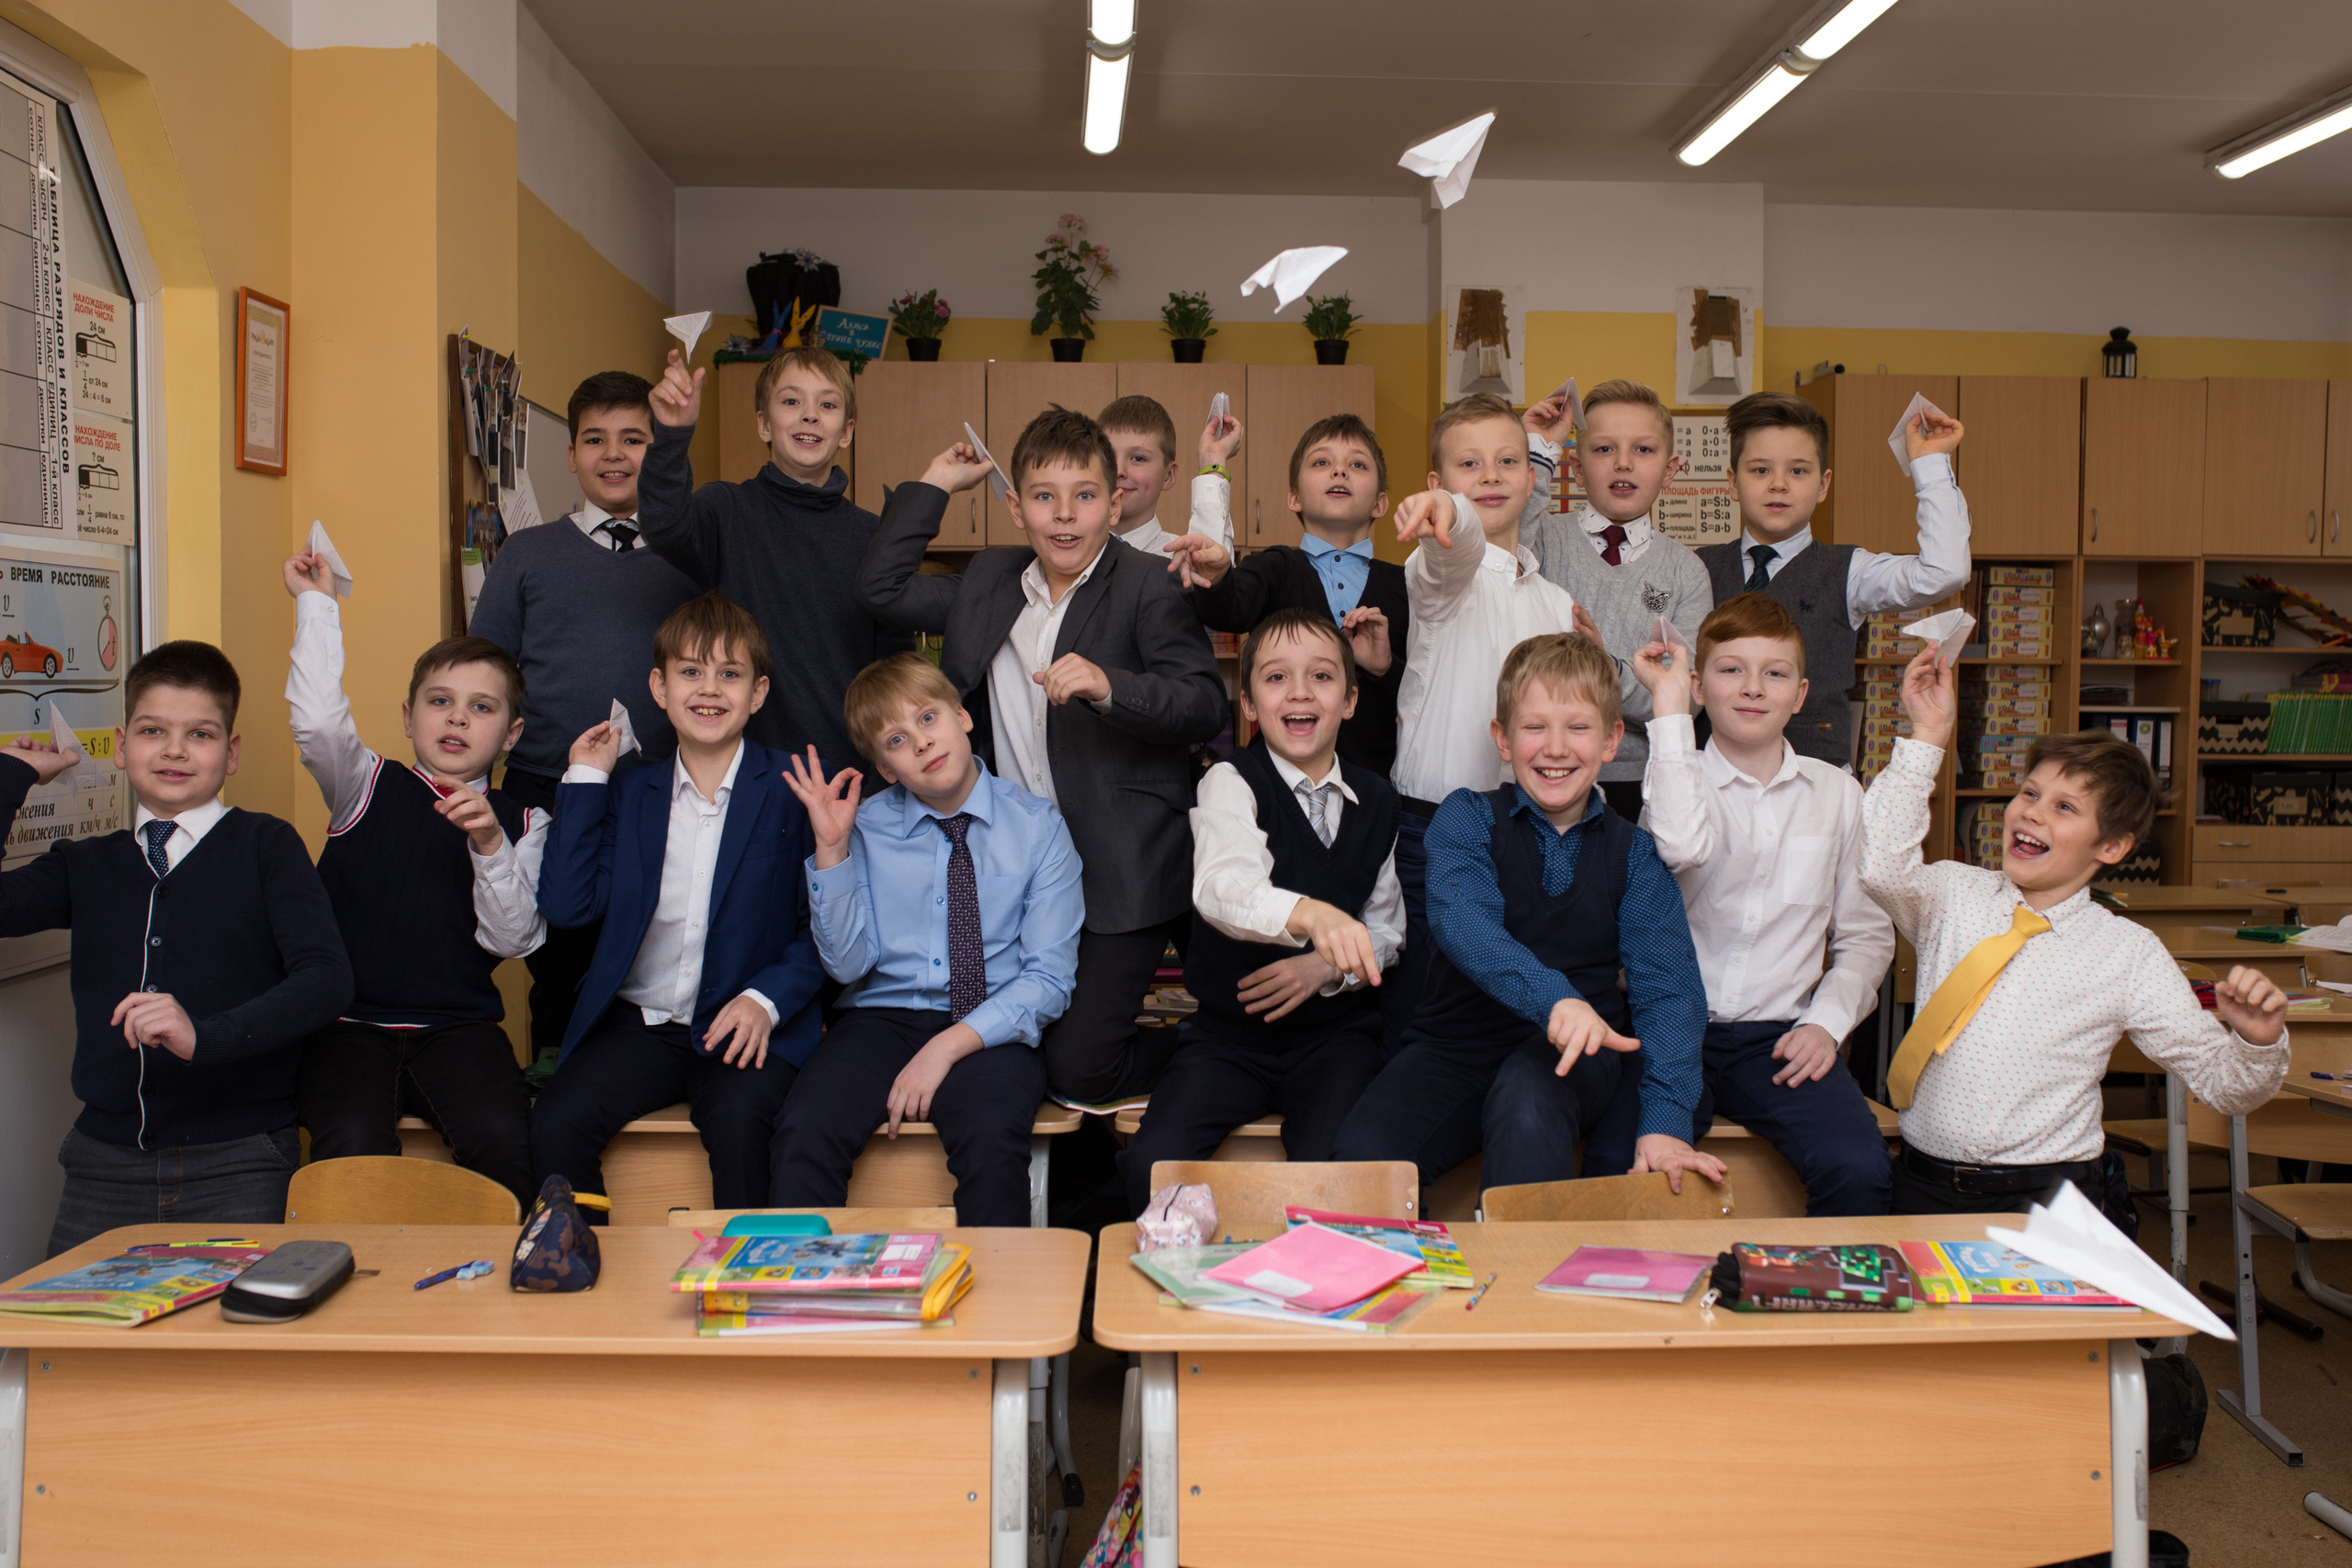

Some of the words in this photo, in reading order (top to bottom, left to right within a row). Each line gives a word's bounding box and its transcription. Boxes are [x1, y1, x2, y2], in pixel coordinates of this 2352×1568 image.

[37, 115, 45, 163] КЛАСС
[39, 169, 47, 220] ЫСЯЧ
[49, 165, 60, 254] ТАБЛИЦА
[54, 261, 65, 359] РАЗРЯДОВ
[74, 291, 115, 313] НАХОЖДЕНИЕ
[74, 302, 94, 316] ДОЛИ
[95, 309, 115, 323] ЧИСЛА
[89, 321, 96, 332] 24
[97, 325, 106, 334] см
[46, 327, 54, 374] КЛАСС
[59, 367, 66, 379] И
[95, 377, 101, 387] 24
[48, 381, 56, 438] ЕДИНИЦ
[60, 387, 70, 474] КЛАССОВ
[75, 424, 118, 441] НАХОЖДЕНИЕ
[95, 438, 104, 448] ПО
[105, 440, 121, 452] ДОЛЕ
[96, 455, 105, 463] см
[1694, 464, 1722, 473] нельзя
[40, 454, 49, 524] единицы
[1660, 487, 1699, 497] ПЛОЩАДЬ
[1700, 487, 1730, 496] ФИГУРЫ
[10, 566, 43, 583] ВРЕМЯ
[51, 570, 110, 590] РАССТОЯНИЕ
[17, 822, 74, 844] движения
[80, 814, 101, 834] км/ч
